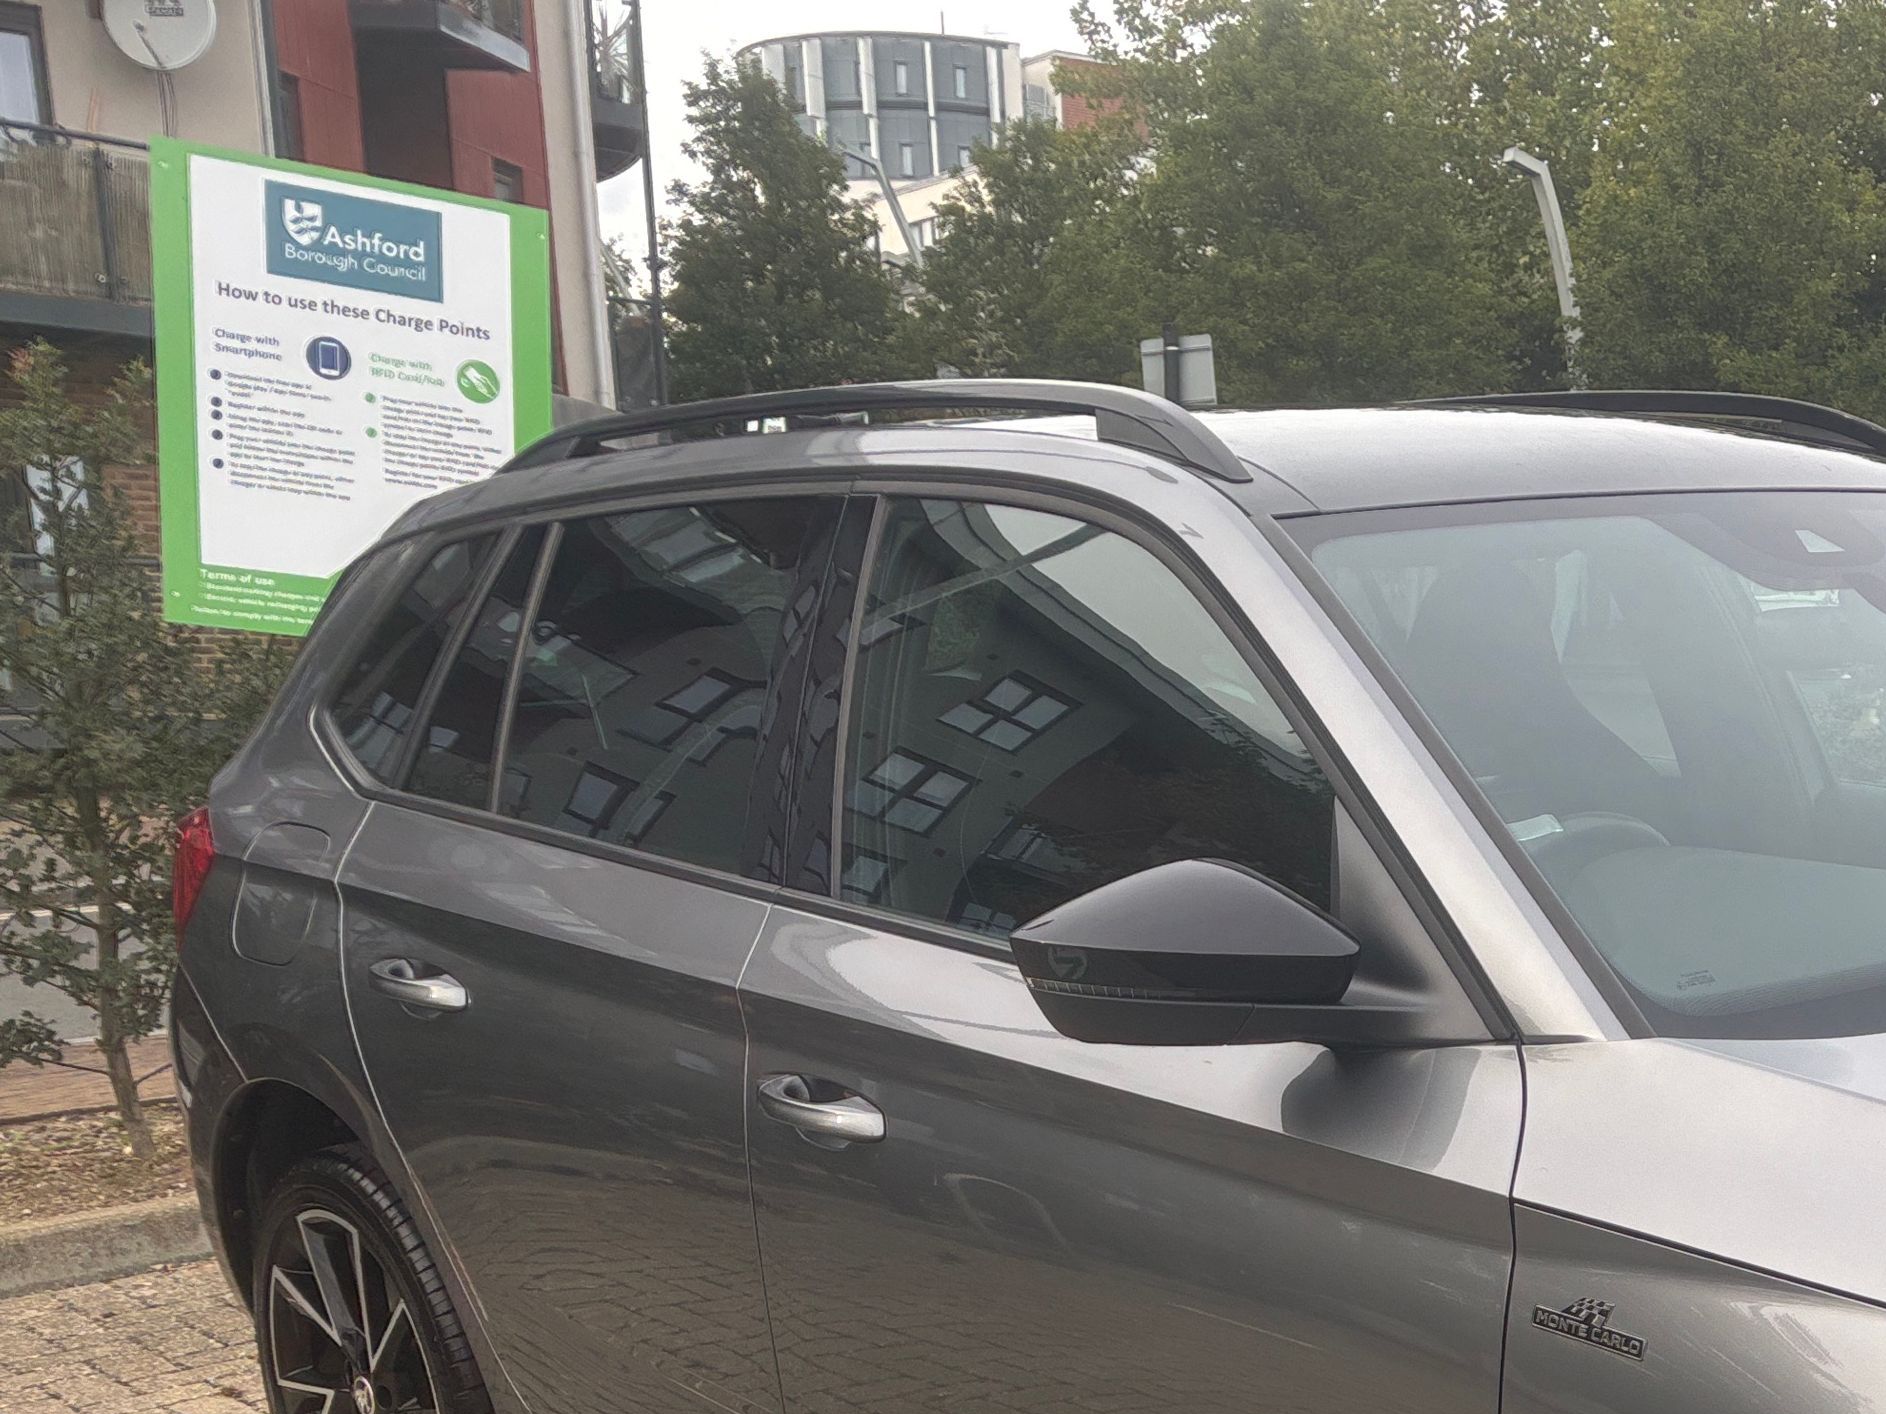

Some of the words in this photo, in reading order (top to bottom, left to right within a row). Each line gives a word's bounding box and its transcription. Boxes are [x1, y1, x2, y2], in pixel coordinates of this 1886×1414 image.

[284, 243, 358, 272] Borough
[363, 258, 426, 281] Council
[323, 225, 425, 262] Ashford
[217, 281, 258, 301] How
[263, 290, 282, 306] to
[288, 295, 317, 311] use
[323, 299, 370, 320] these
[375, 308, 434, 332] Charge
[438, 318, 491, 341] Points
[214, 328, 252, 344] Charge
[255, 334, 280, 347] with
[214, 342, 283, 361] Smartphone
[200, 568, 237, 582] Terms
[239, 573, 252, 584] of
[255, 578, 275, 587] use
[1536, 1310, 1588, 1337] MONTE
[1591, 1328, 1640, 1355] CARLO
